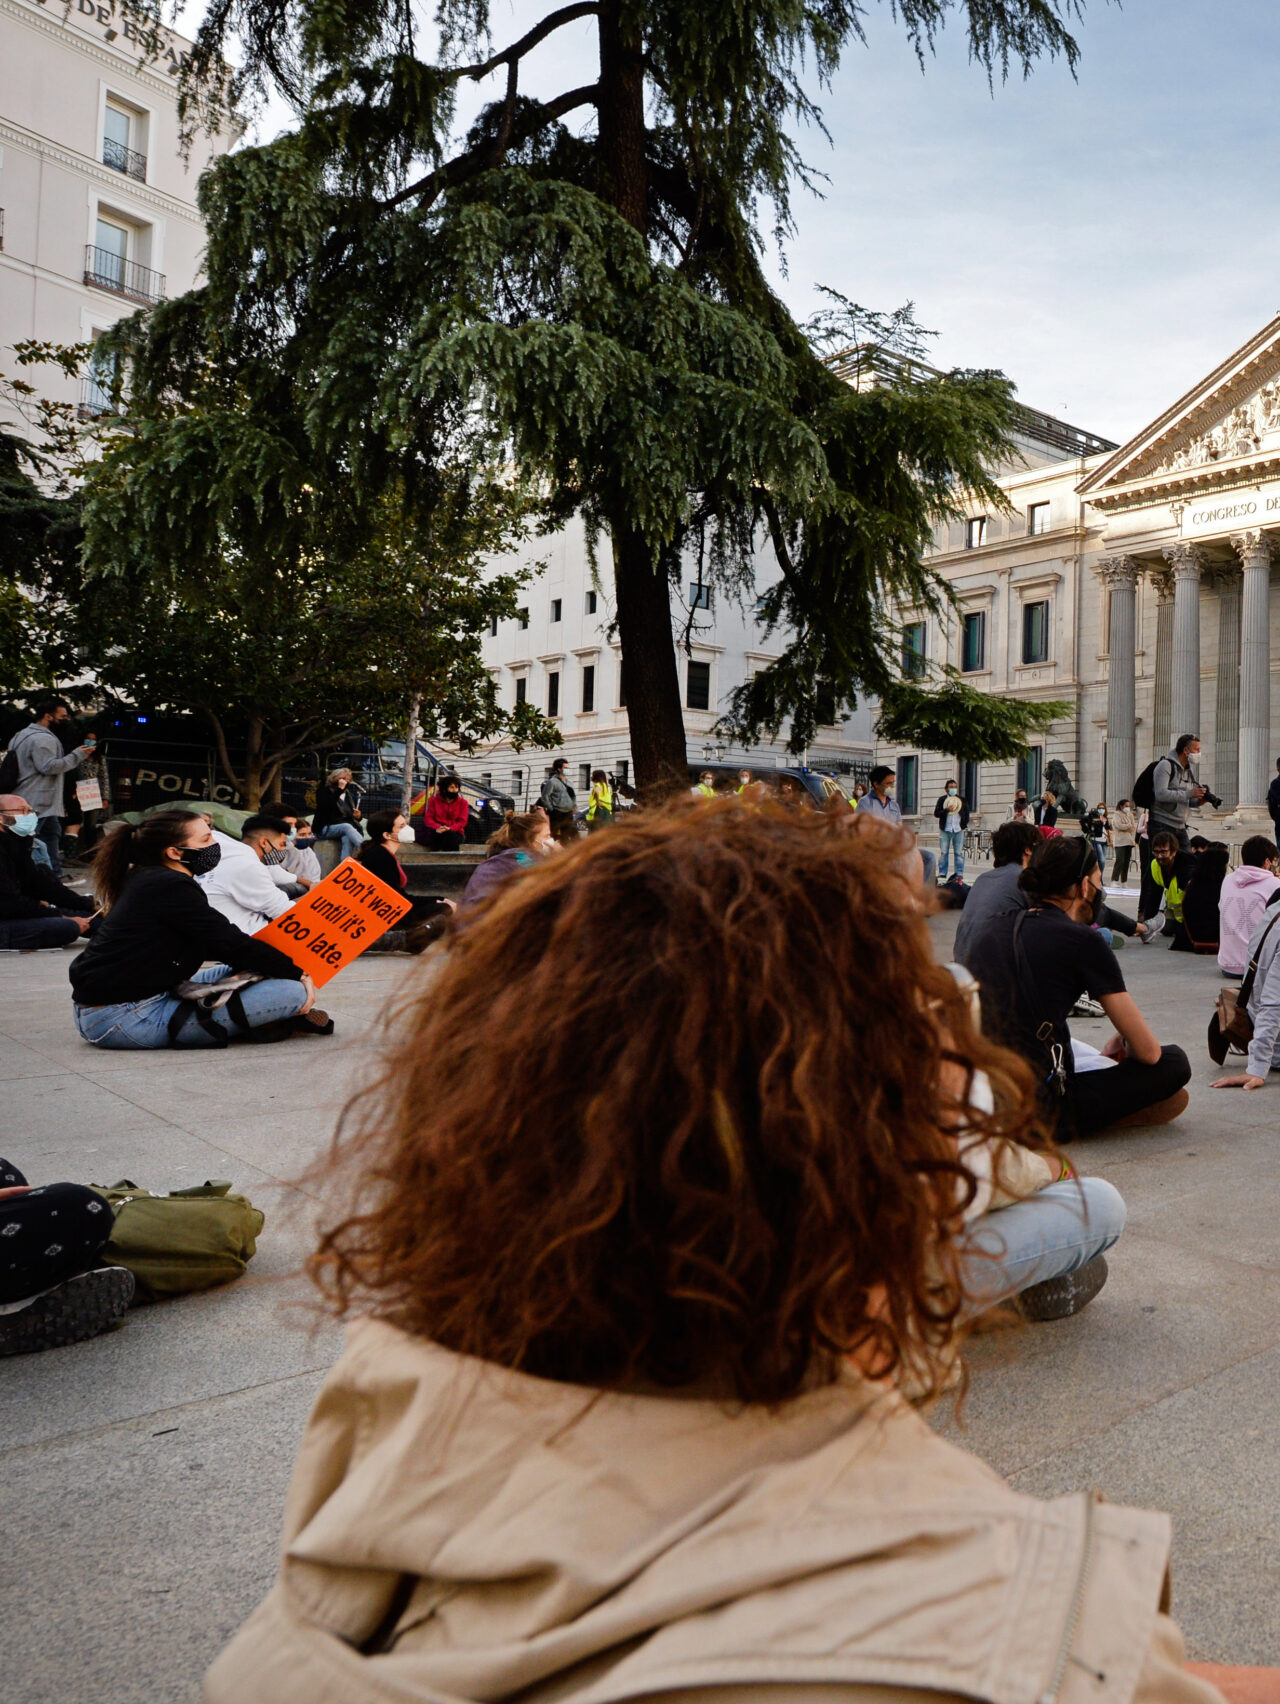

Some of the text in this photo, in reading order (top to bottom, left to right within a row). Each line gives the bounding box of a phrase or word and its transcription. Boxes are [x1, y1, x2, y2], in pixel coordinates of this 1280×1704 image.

[77, 0, 200, 73] DE ESPA
[1192, 502, 1257, 525] CONGRESO
[1266, 497, 1280, 511] DE
[310, 896, 366, 939] until it's
[332, 867, 403, 924] Don't wait
[277, 914, 342, 968] too late.
